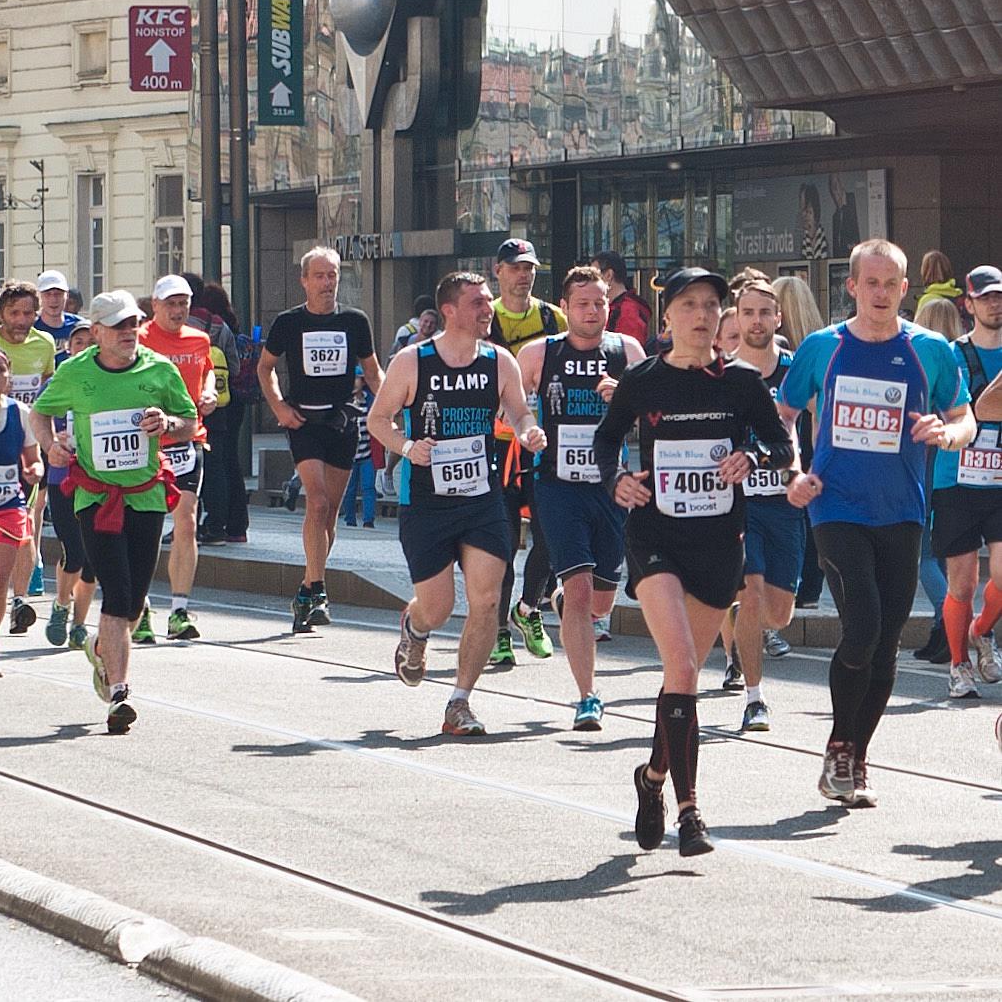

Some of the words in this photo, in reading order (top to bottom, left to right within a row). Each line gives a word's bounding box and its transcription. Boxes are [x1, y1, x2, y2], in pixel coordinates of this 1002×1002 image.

[136, 8, 186, 25] KFC
[135, 28, 186, 37] NONSTOP
[140, 75, 168, 89] 400
[170, 80, 182, 89] m
[310, 349, 340, 362] 3627
[565, 360, 607, 375] SLEE
[430, 373, 489, 391] CLAMP
[101, 434, 140, 453] 7010
[442, 461, 480, 482] 6501
[689, 502, 717, 511] boost
